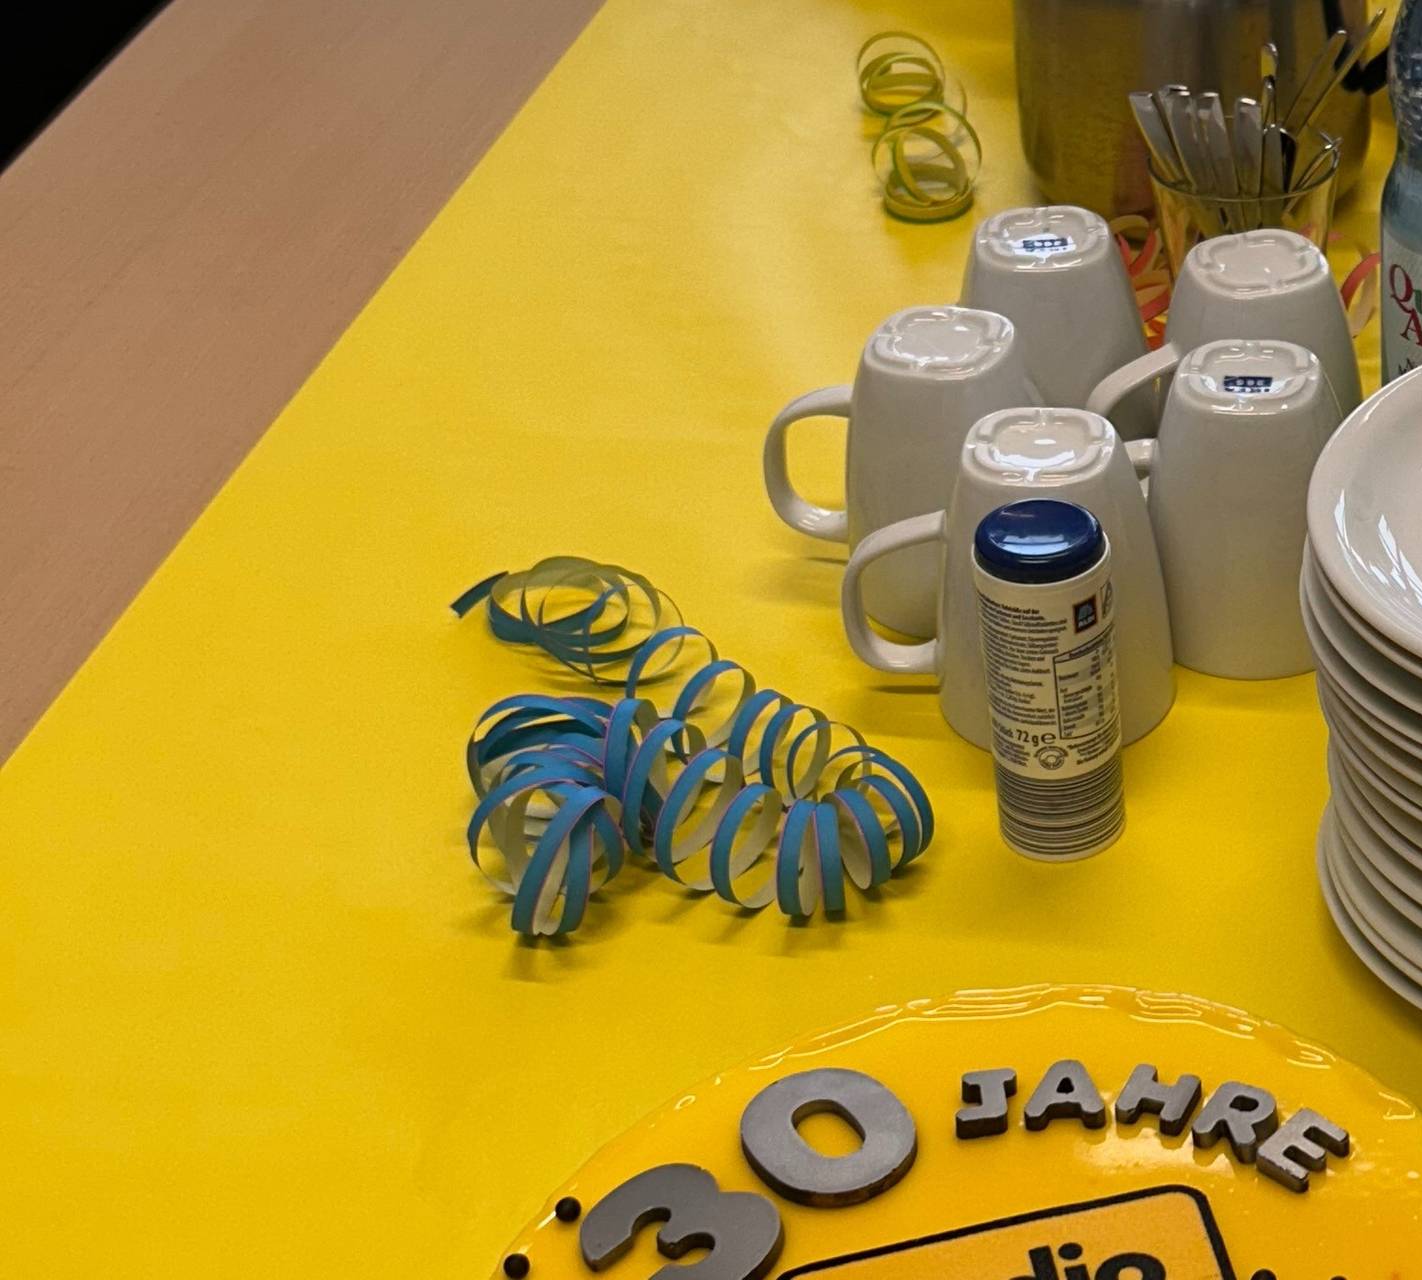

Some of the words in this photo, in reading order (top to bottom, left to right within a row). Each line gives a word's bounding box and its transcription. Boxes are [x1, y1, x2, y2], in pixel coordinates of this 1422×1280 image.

[1016, 729, 1030, 742] 72
[580, 1067, 917, 1280] 30
[956, 1060, 1350, 1193] JAHRE
